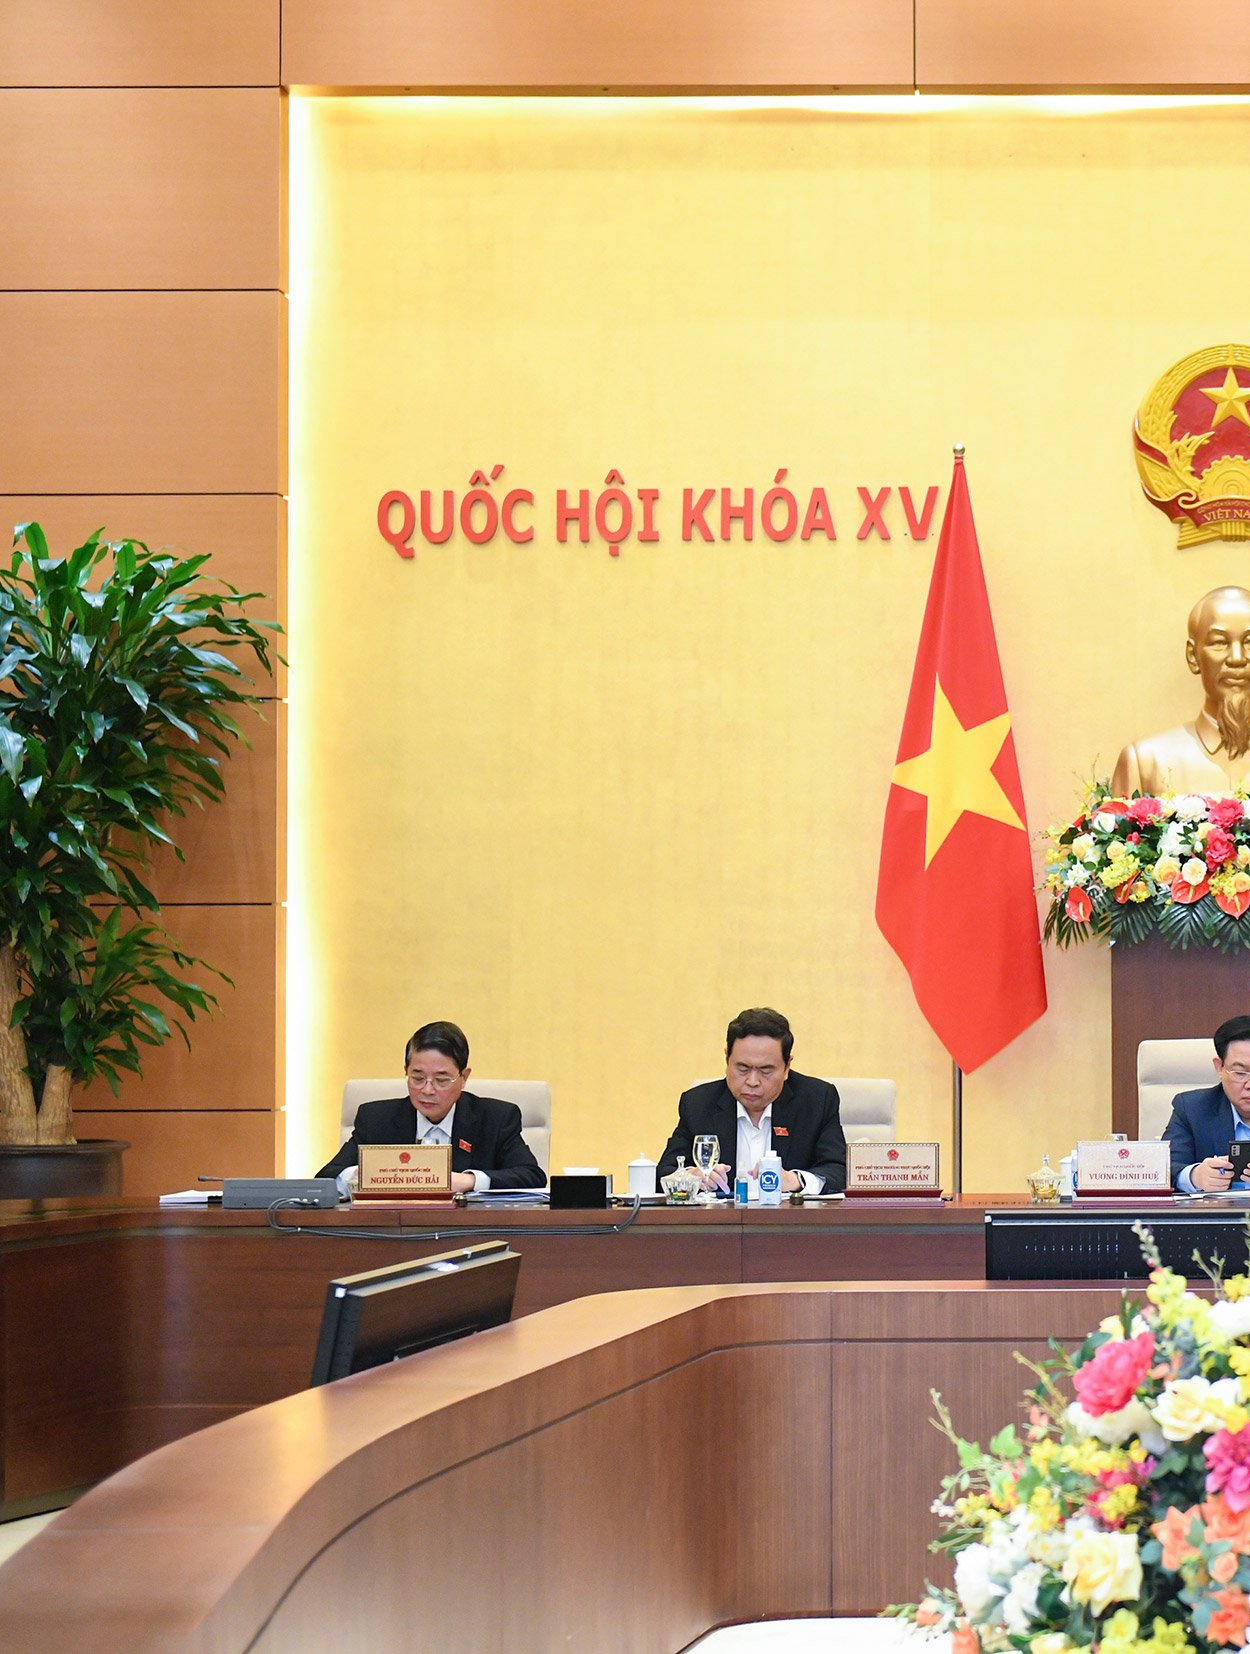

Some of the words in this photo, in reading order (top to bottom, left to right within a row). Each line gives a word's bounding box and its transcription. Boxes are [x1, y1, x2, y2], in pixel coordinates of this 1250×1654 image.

[377, 464, 534, 558] QUỐC
[556, 469, 659, 556] HỘI
[682, 468, 837, 543] KHÓA
[857, 485, 939, 542] XV
[761, 1174, 777, 1185] ICY
